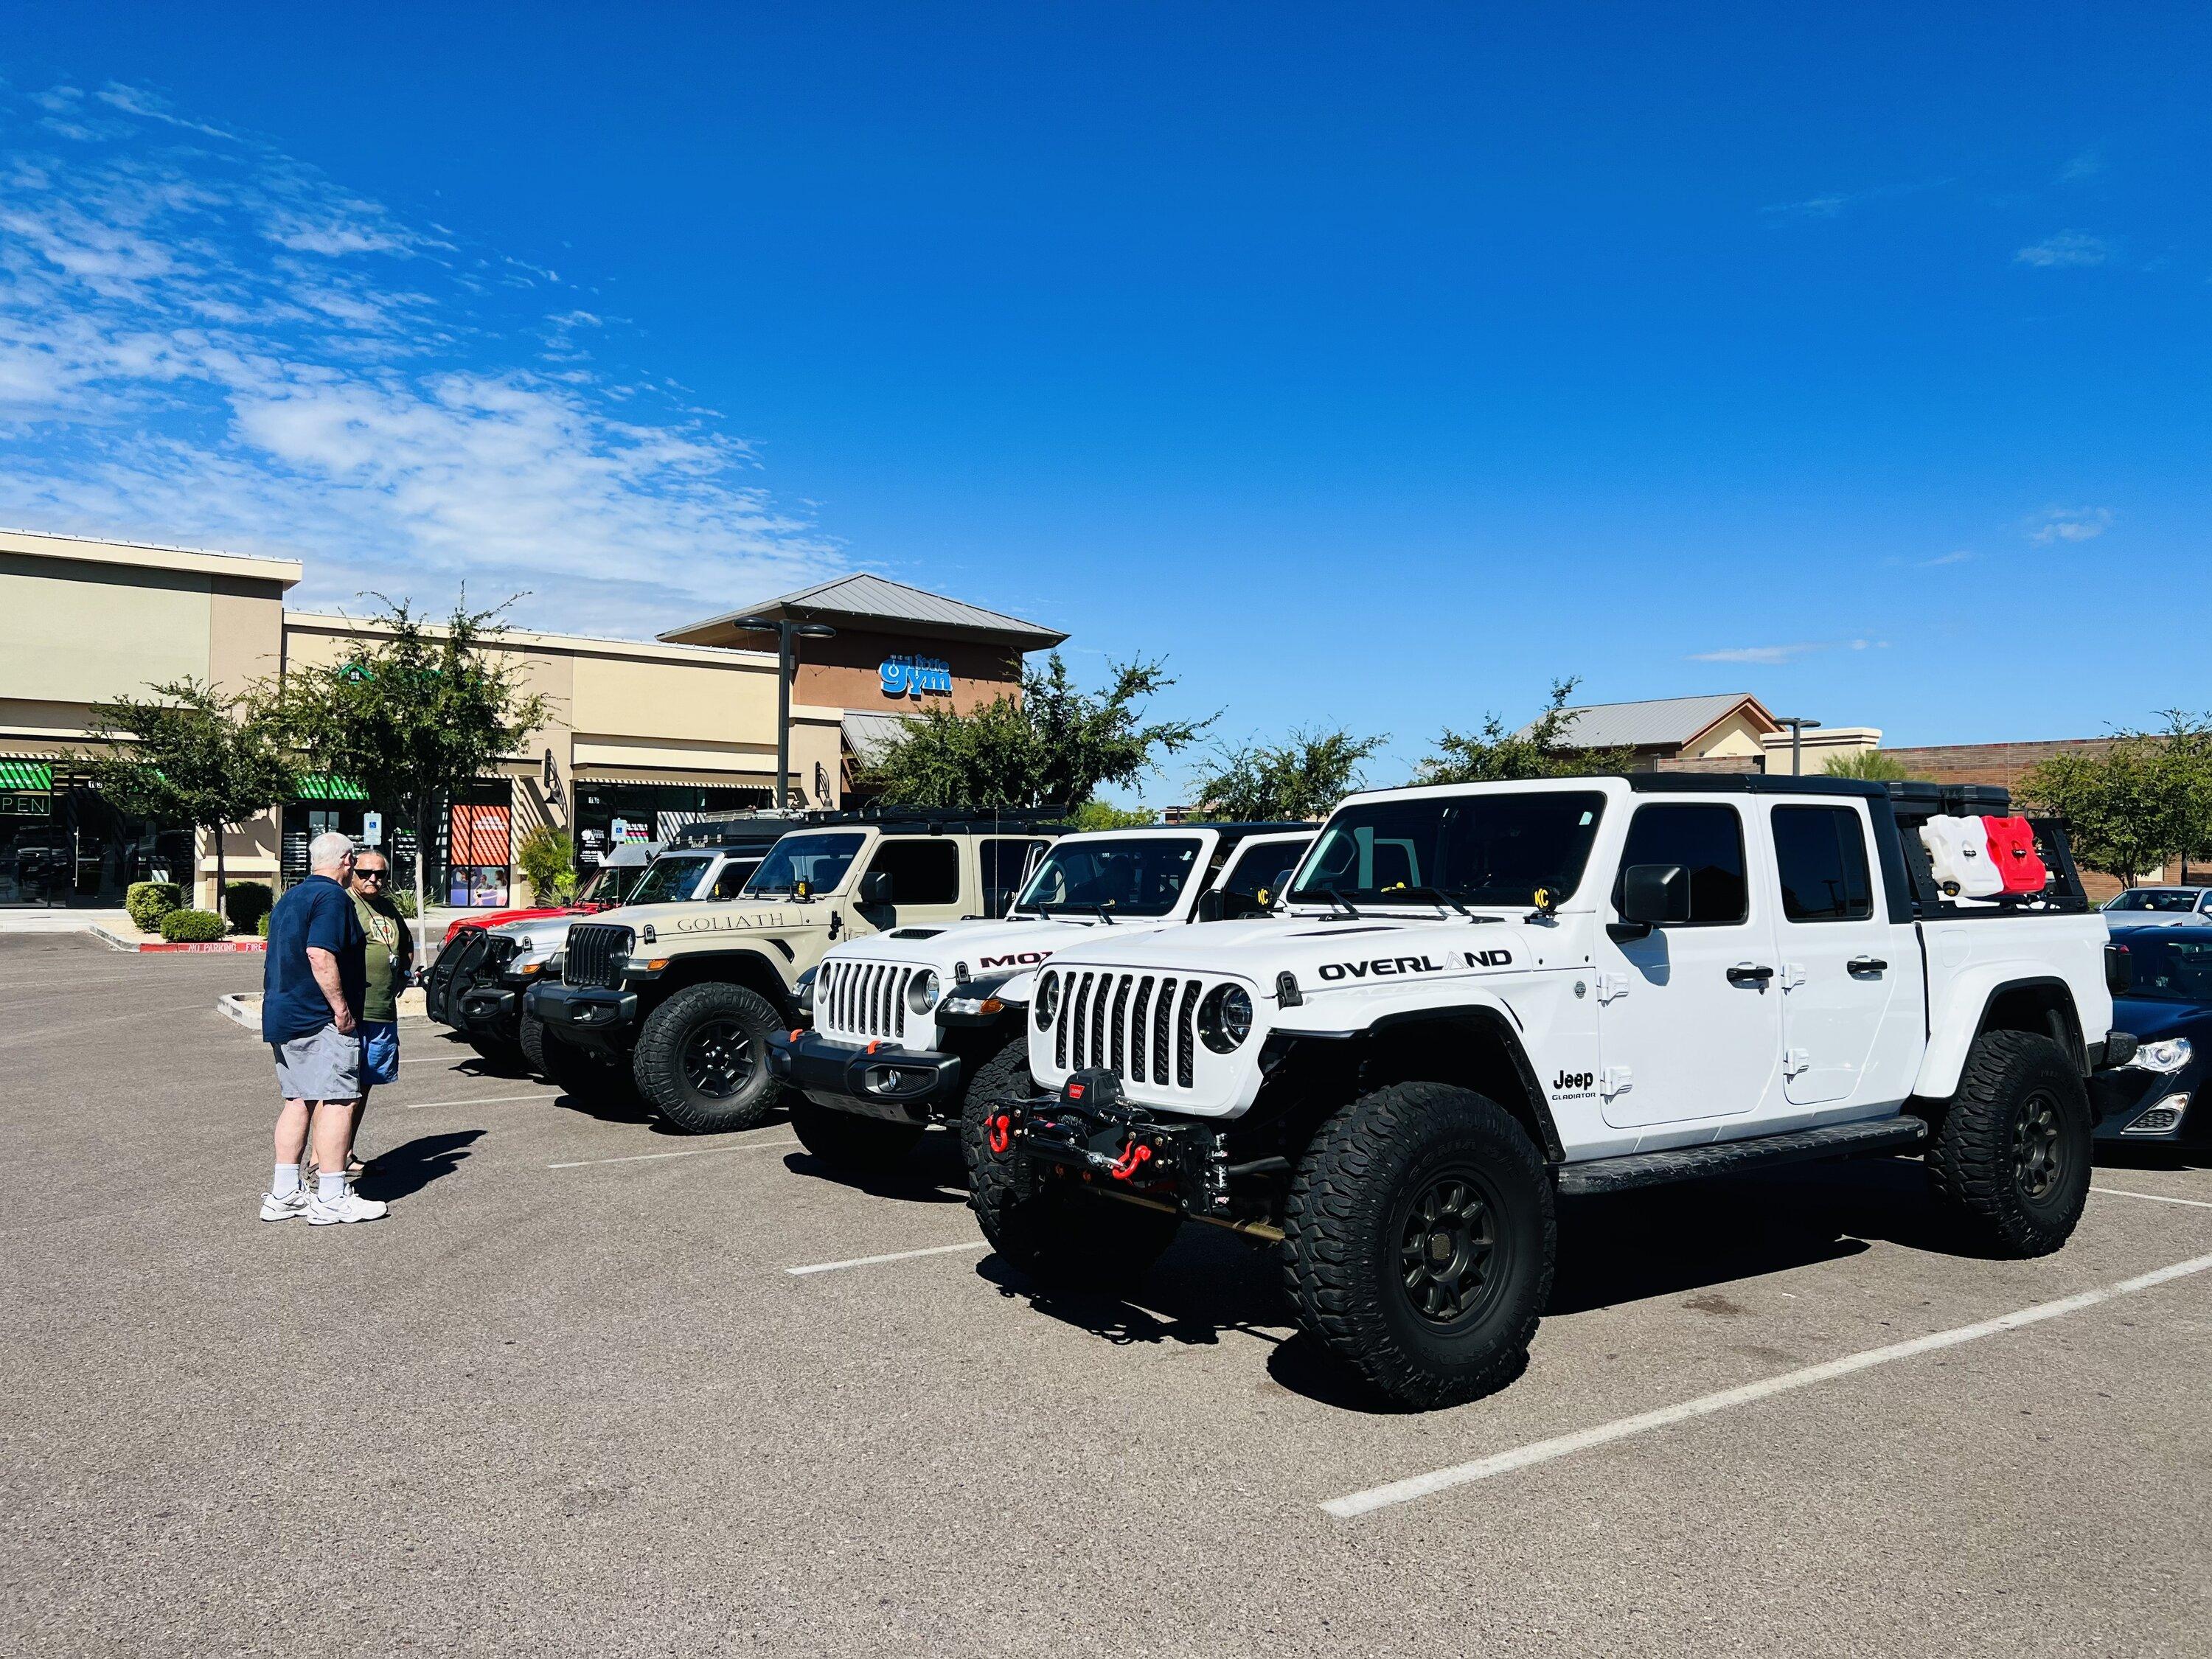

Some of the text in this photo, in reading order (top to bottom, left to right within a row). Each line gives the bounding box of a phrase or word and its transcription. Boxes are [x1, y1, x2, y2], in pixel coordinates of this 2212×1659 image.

[879, 659, 953, 695] gym
[1258, 888, 1268, 905] KC
[1534, 888, 1548, 908] KC
[678, 913, 784, 931] GOLIATH
[188, 943, 262, 953] NO PARKING FIRE
[1318, 949, 1512, 981] OVERLAND
[1553, 1070, 1593, 1091] Jeep
[1551, 1092, 1596, 1101] GLADIATOR
